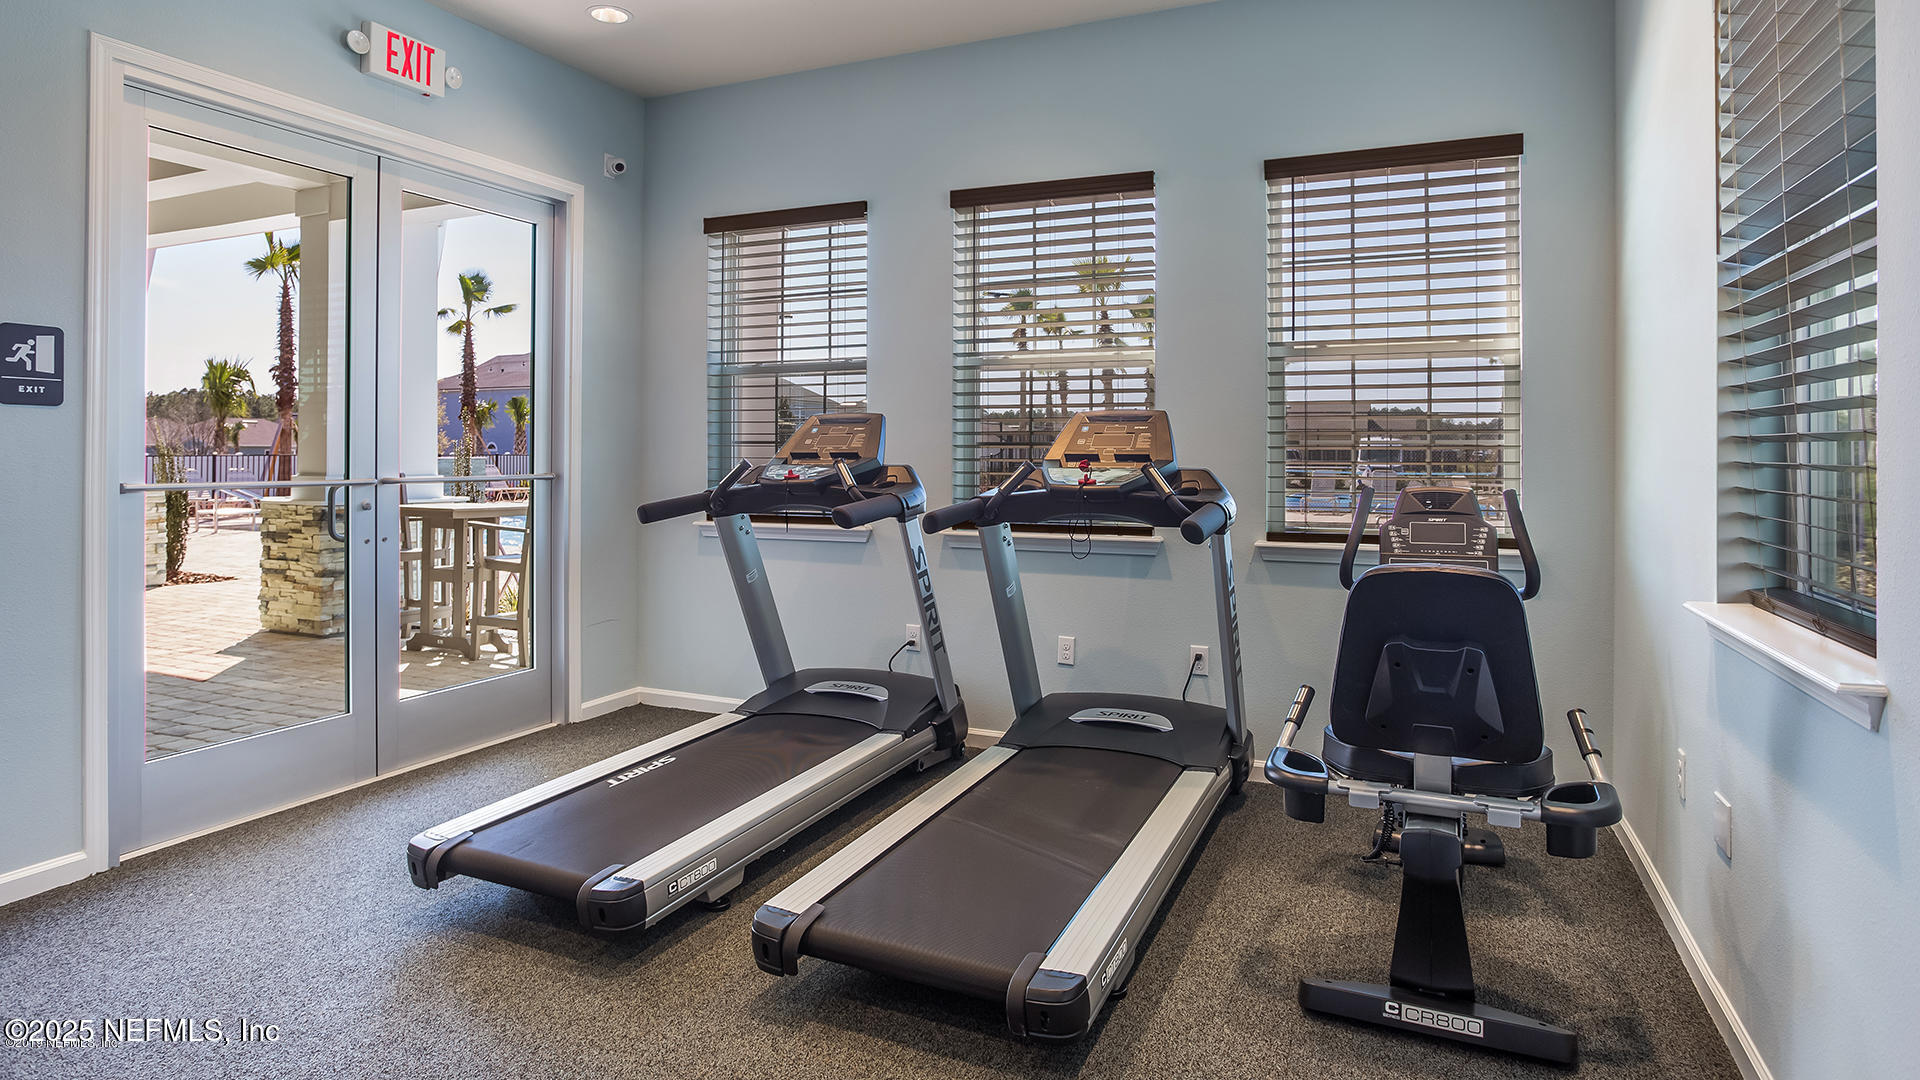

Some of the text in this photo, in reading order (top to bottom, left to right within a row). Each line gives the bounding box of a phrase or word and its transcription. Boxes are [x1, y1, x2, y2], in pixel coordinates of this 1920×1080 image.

[386, 30, 435, 87] EXIT
[18, 385, 46, 393] EXIT
[911, 545, 946, 654] SPIRIT
[830, 683, 873, 691] SPIRIT
[1097, 711, 1149, 720] SPIRIT
[606, 755, 677, 788] SPIRIT
[680, 860, 715, 889] CT800
[1385, 1001, 1399, 1015] C
[1405, 1007, 1481, 1035] CR800
